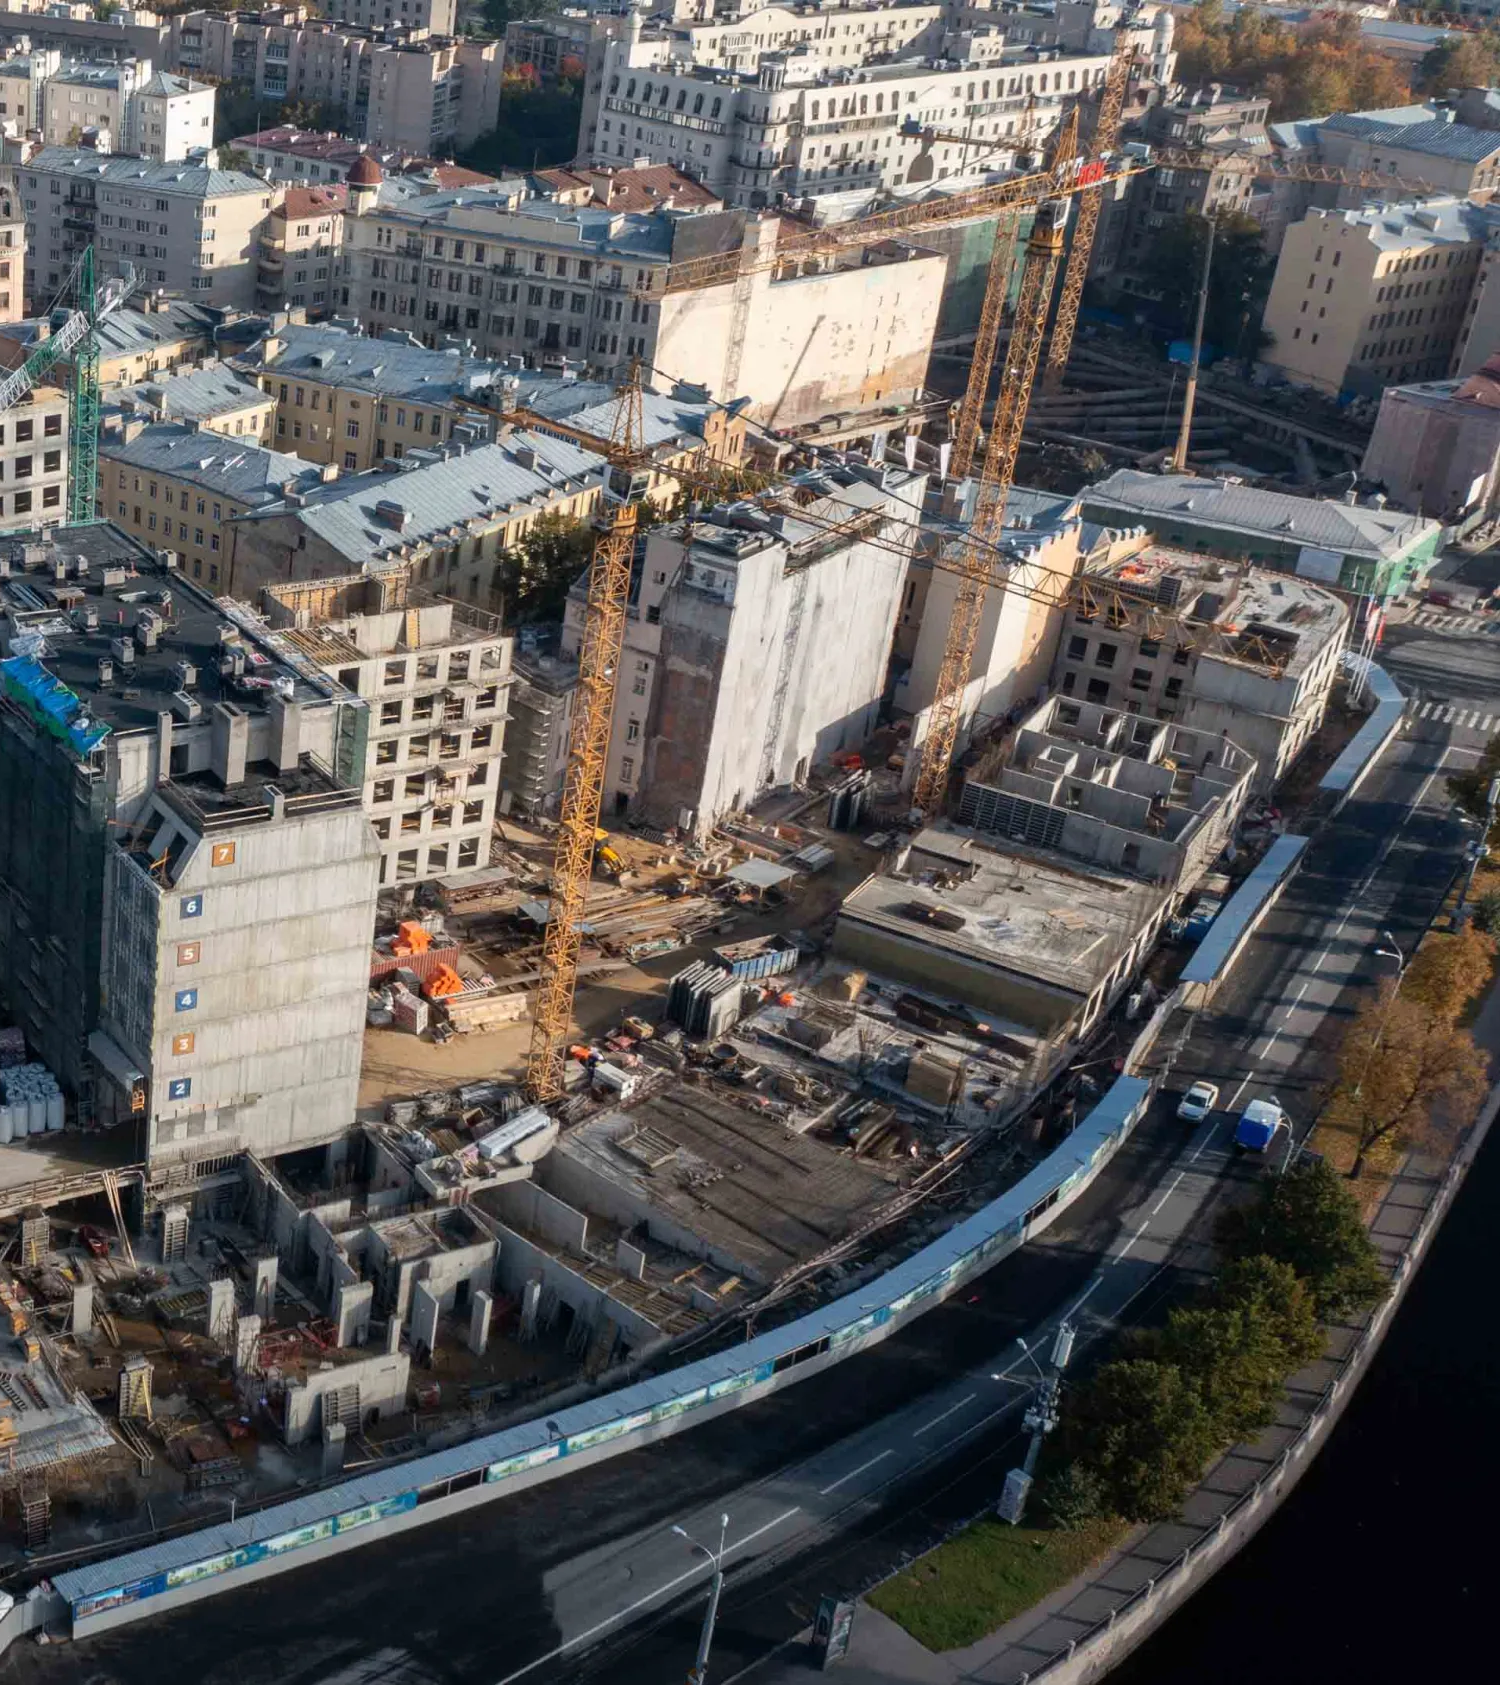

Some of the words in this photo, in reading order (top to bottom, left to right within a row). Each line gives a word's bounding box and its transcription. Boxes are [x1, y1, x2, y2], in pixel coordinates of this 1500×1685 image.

[219, 847, 229, 861] 7
[186, 900, 196, 913] 6
[183, 948, 194, 961] 5
[181, 993, 192, 1006] 4
[178, 1038, 189, 1051] 3
[175, 1082, 185, 1095] 2
